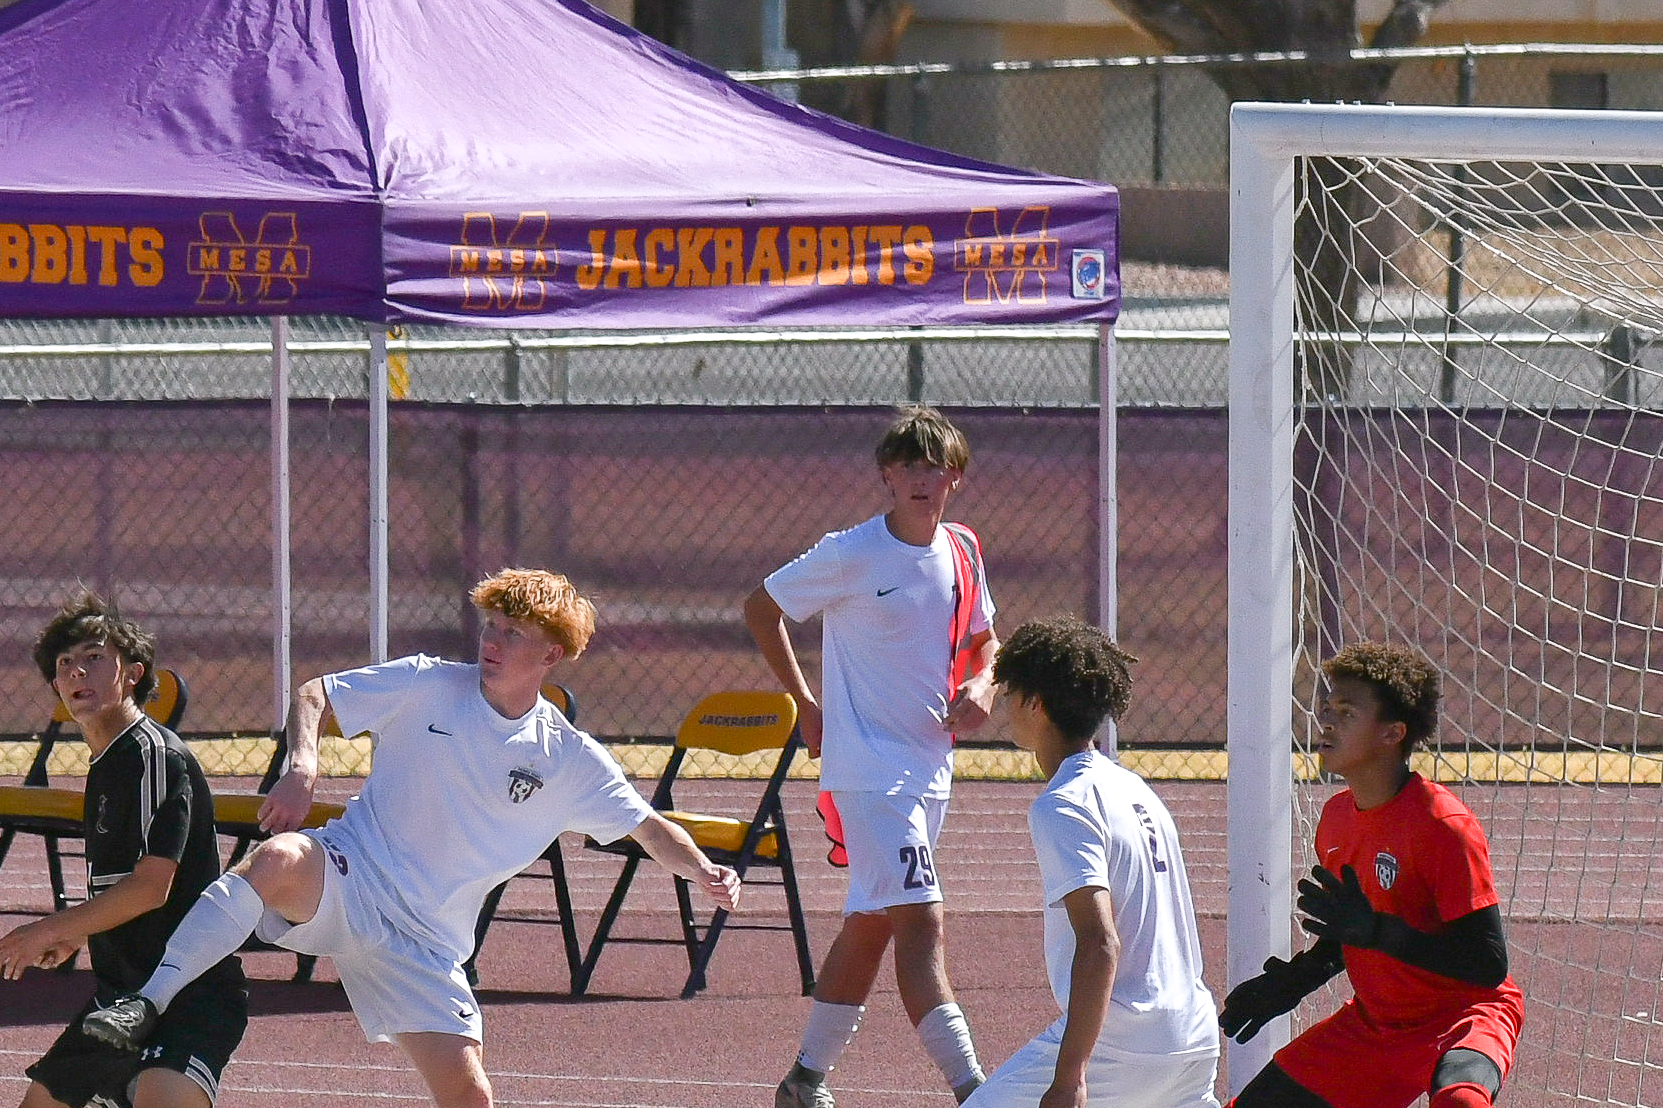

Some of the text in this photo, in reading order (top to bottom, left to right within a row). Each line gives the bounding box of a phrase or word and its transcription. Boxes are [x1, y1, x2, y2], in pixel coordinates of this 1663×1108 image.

[200, 248, 298, 272] MESA
[460, 225, 1048, 290] MESA JACKRABBITS MESA
[899, 845, 935, 890] 29
